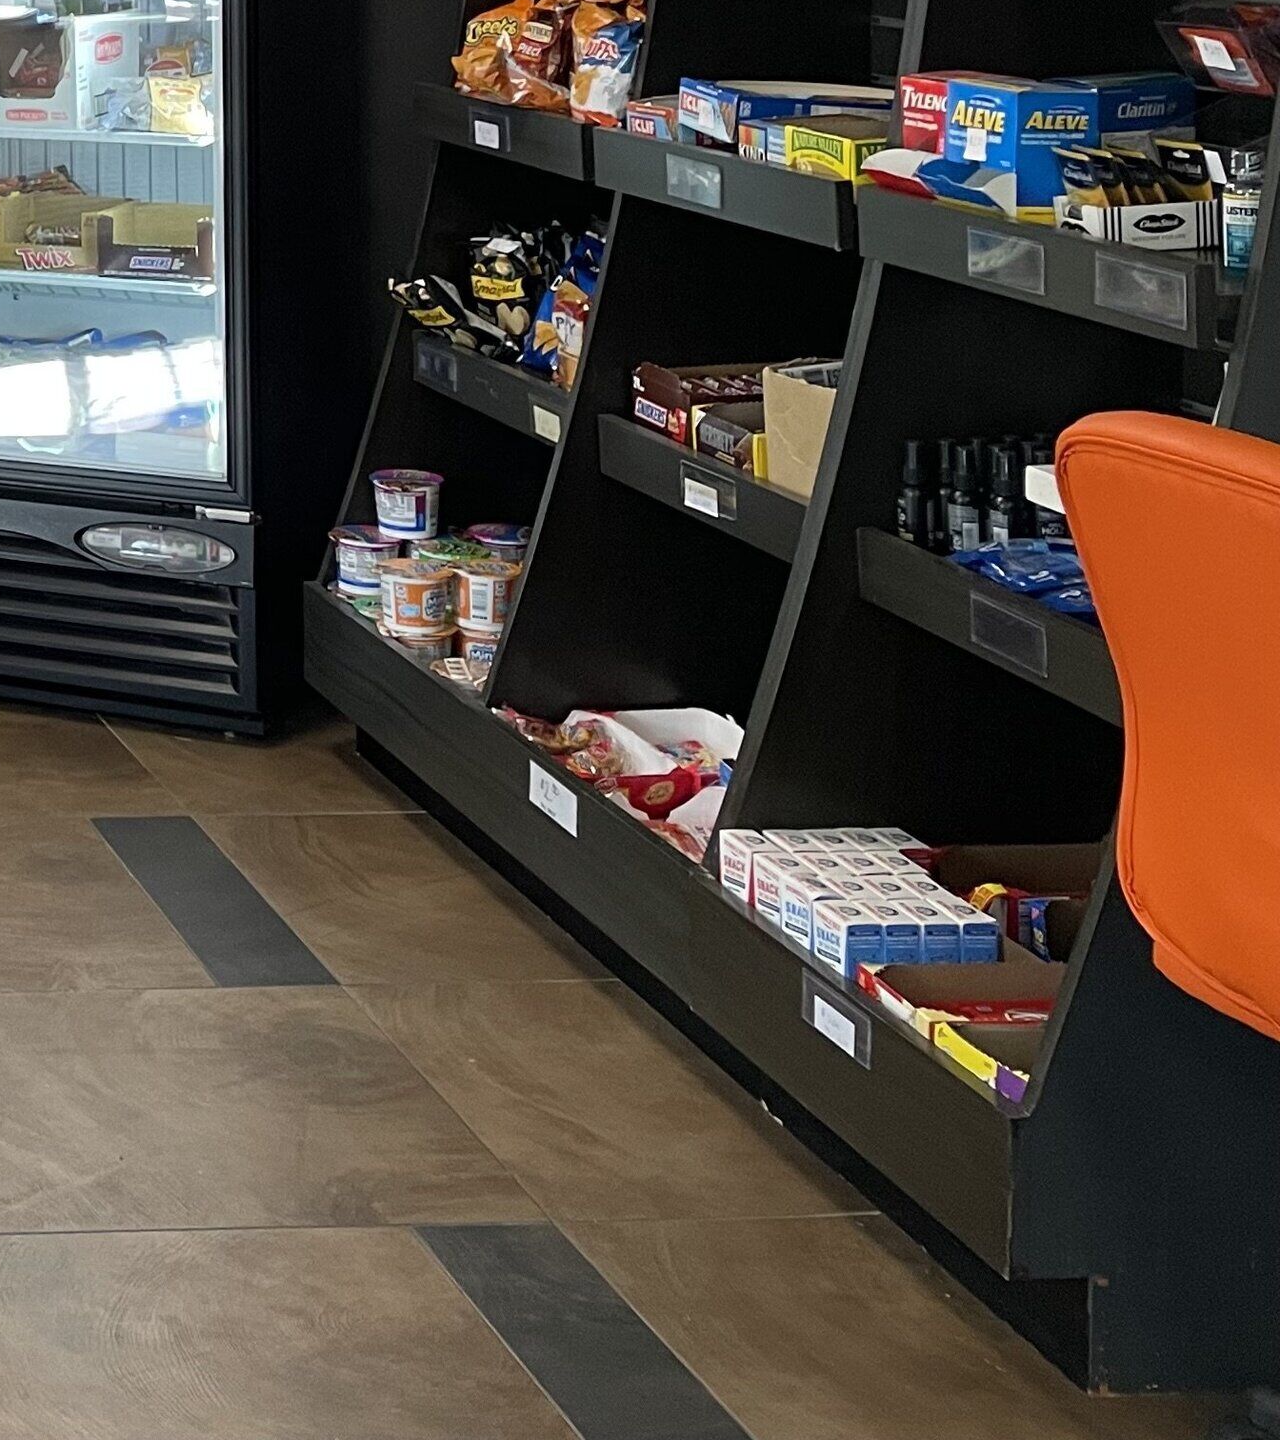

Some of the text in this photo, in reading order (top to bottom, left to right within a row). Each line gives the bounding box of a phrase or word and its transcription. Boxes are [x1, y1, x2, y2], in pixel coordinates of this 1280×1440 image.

[951, 100, 1006, 132] ALEVE
[1118, 102, 1165, 118] Claritin
[1025, 112, 1089, 130] ALEVE
